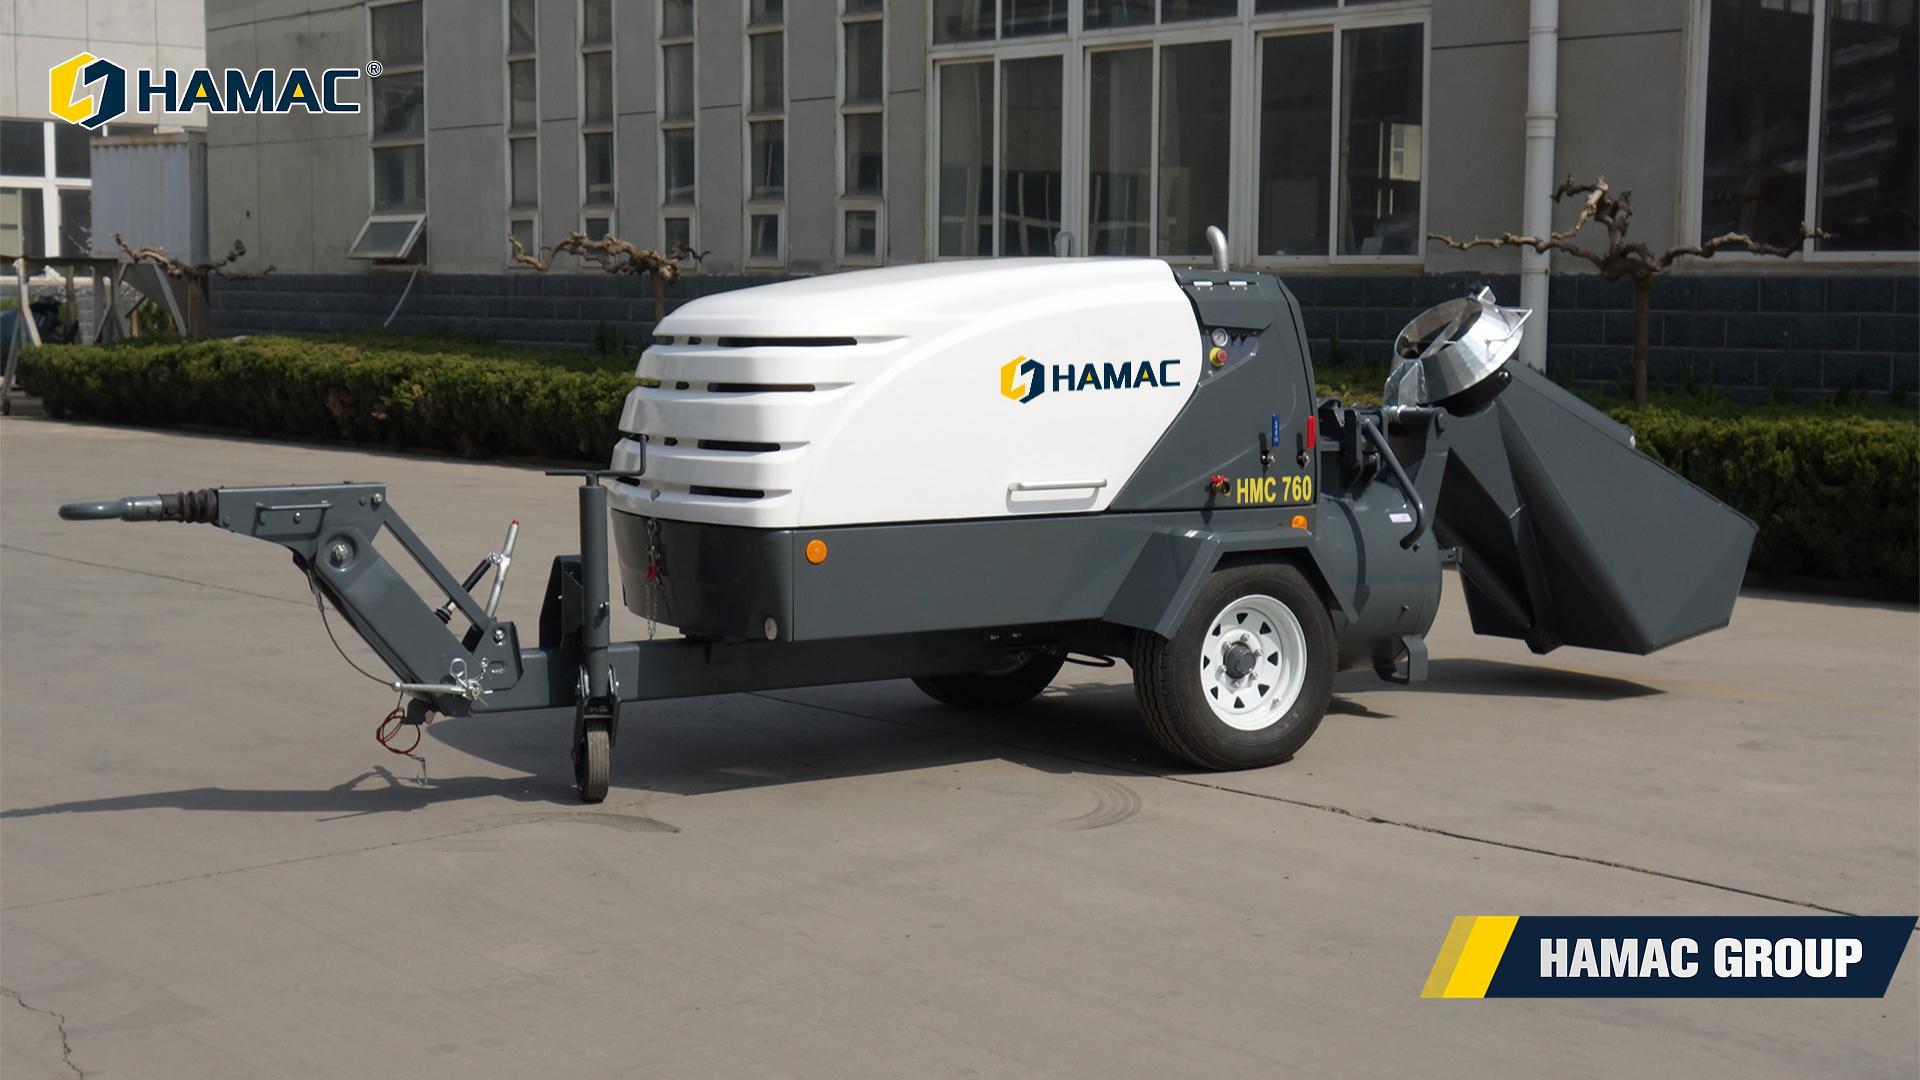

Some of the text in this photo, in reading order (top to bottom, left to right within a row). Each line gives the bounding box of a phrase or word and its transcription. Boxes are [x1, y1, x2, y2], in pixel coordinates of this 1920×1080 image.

[1052, 359, 1181, 392] HAMAC
[1236, 475, 1312, 504] HMC 760
